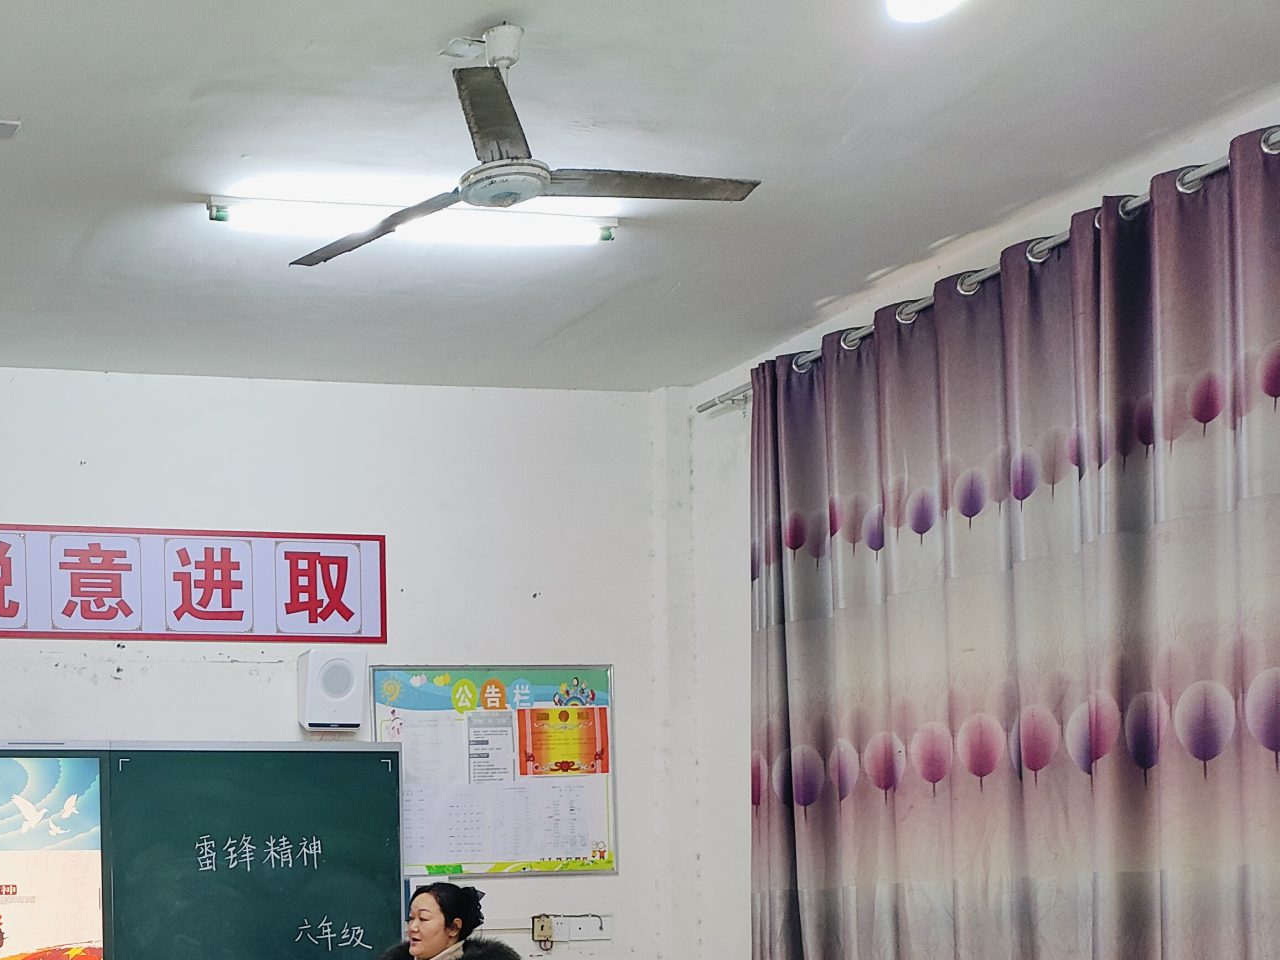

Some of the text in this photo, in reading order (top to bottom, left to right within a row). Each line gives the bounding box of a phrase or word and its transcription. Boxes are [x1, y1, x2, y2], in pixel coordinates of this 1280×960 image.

[455, 685, 531, 708] 公告栏
[195, 834, 322, 872] 雷锋精神
[295, 915, 373, 951] 六年级
